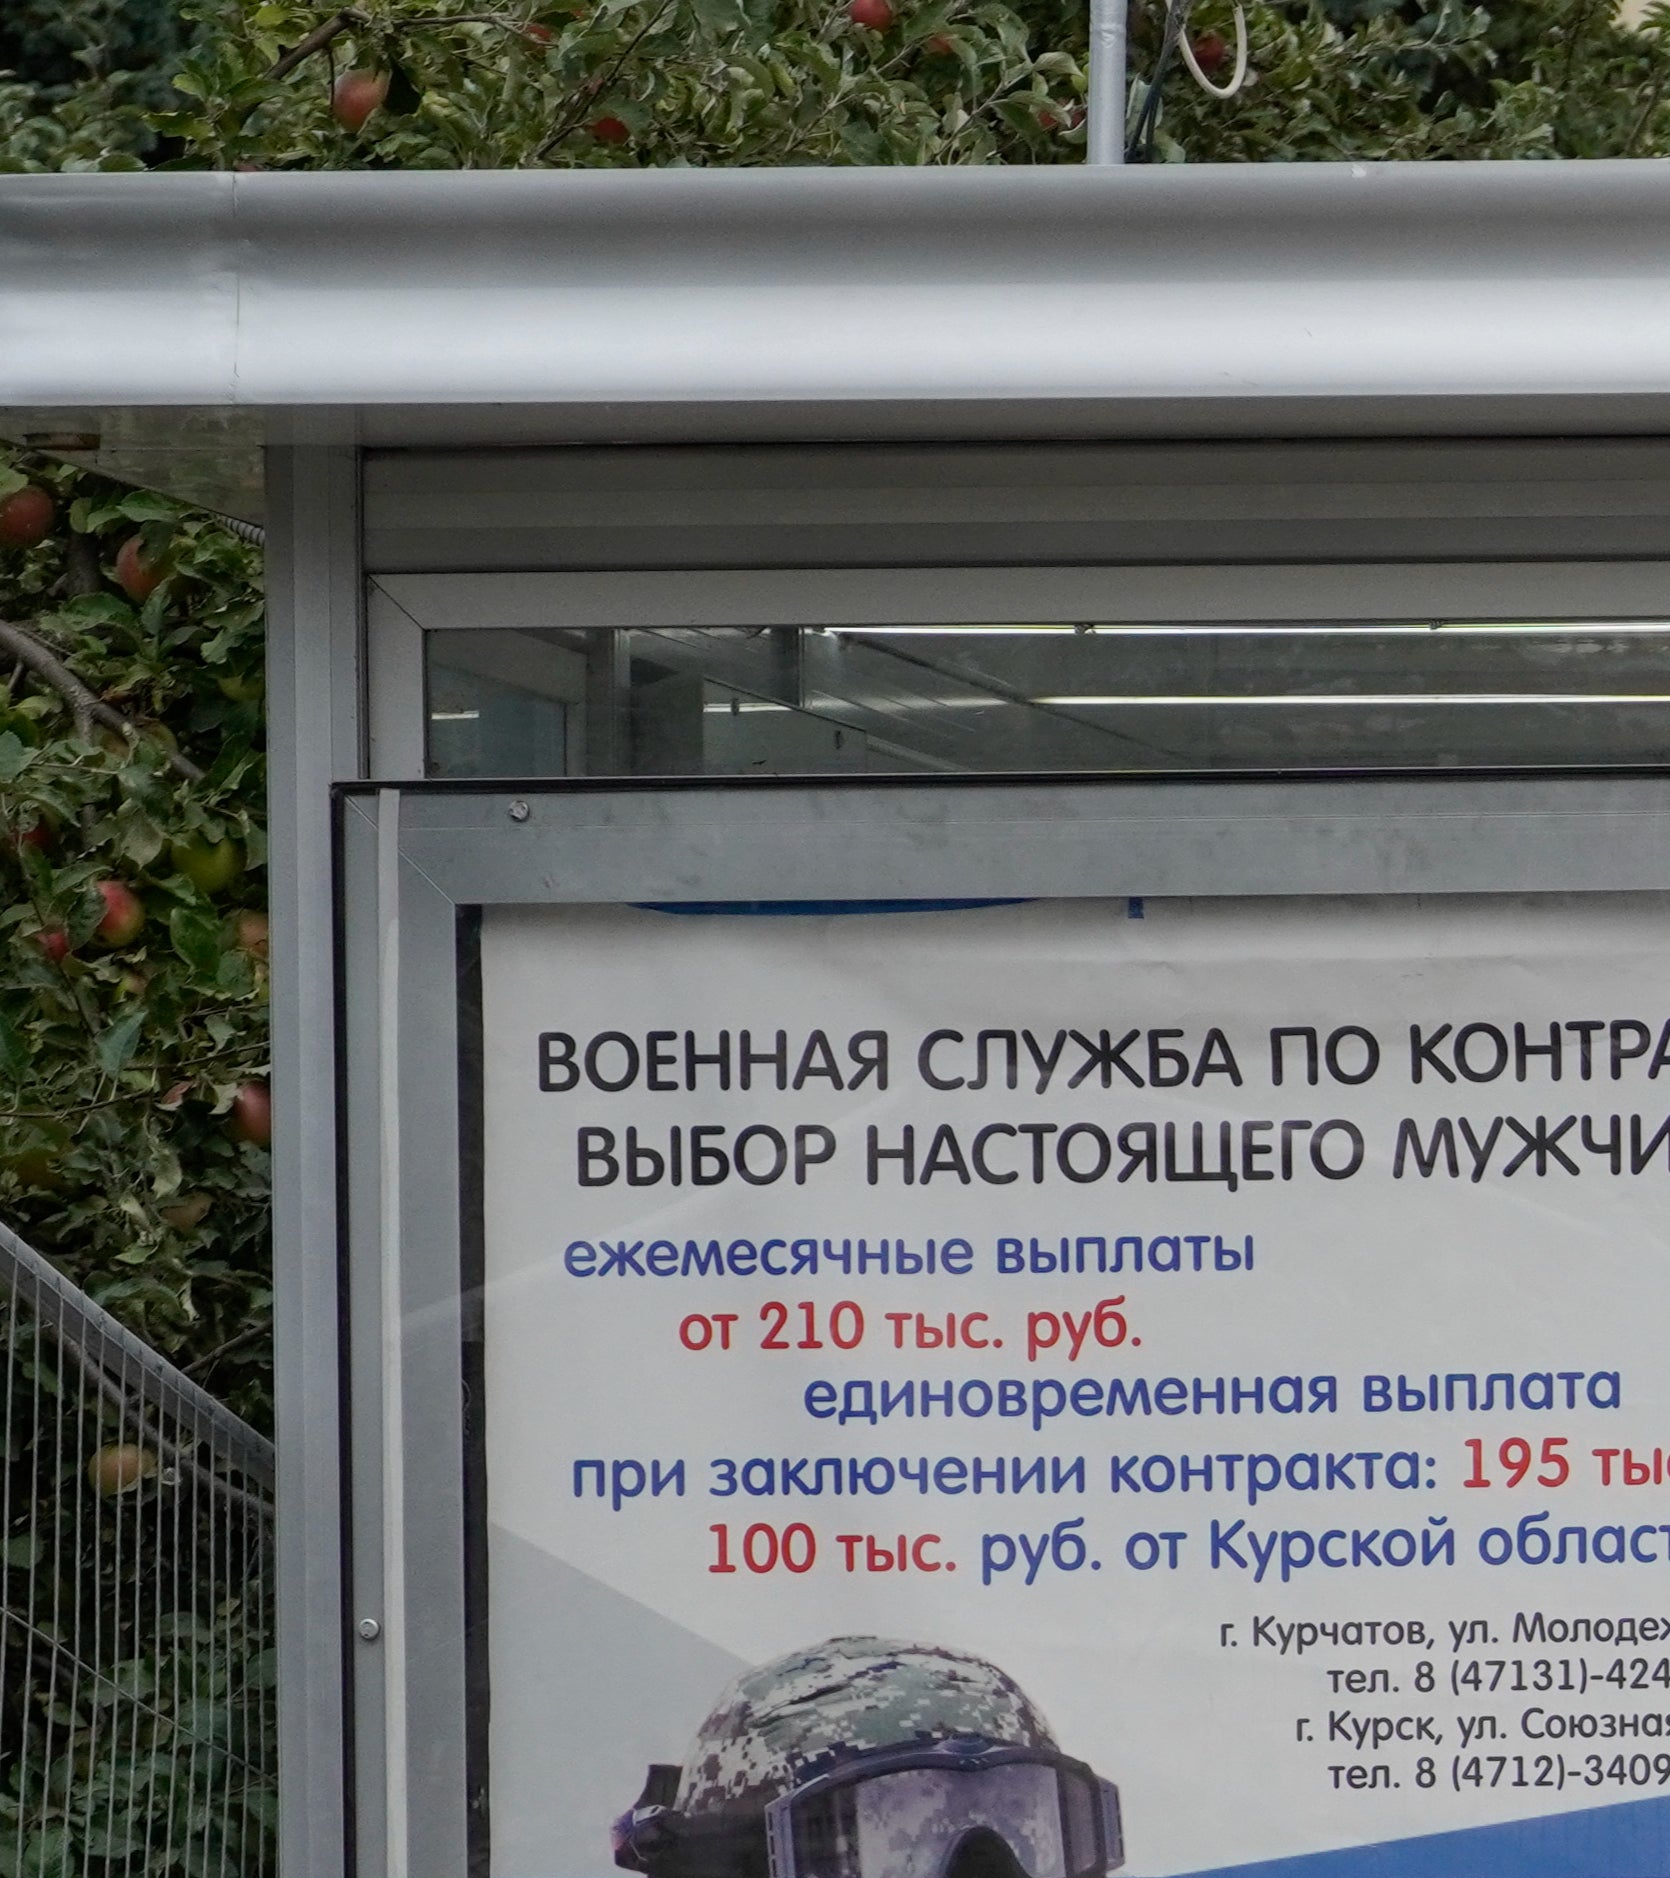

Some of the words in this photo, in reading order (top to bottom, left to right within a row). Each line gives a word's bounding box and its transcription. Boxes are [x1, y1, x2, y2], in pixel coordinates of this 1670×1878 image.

[539, 1029, 888, 1092] ВОЕННАЯ
[919, 1028, 1243, 1094] СЛУЖБА
[1270, 1025, 1380, 1086] ПО
[578, 1124, 836, 1187] ВЫБОР
[867, 1119, 1364, 1192] НАСТОЯЩЕГО
[564, 1238, 973, 1277] ежемесячные
[998, 1235, 1253, 1273] выплаты
[679, 1314, 739, 1351] от
[760, 1301, 864, 1349] 210
[885, 1312, 1003, 1348] тыс.
[1028, 1295, 1141, 1362] руб.
[804, 1377, 1337, 1430] единовременная
[1364, 1371, 1620, 1412] выплата
[573, 1459, 685, 1512] при
[709, 1456, 1085, 1496] заключении
[1111, 1452, 1436, 1506] контракта:
[1464, 1437, 1569, 1488] 195
[709, 1523, 816, 1574] 100
[835, 1534, 956, 1572] тыс.
[982, 1517, 1101, 1586] руб.
[1126, 1532, 1187, 1570] от
[1211, 1516, 1454, 1582] Курской
[1221, 1624, 1237, 1647] г.
[1253, 1616, 1434, 1655] Курчатов,
[1448, 1620, 1498, 1651] ул.
[1326, 1670, 1399, 1693] тел.
[1415, 1661, 1435, 1692] 8
[1297, 1718, 1313, 1742] г.
[1329, 1710, 1443, 1750] Курск,
[1457, 1716, 1507, 1749] ул.
[1328, 1765, 1400, 1789] тел.
[1416, 1757, 1436, 1788] 8
